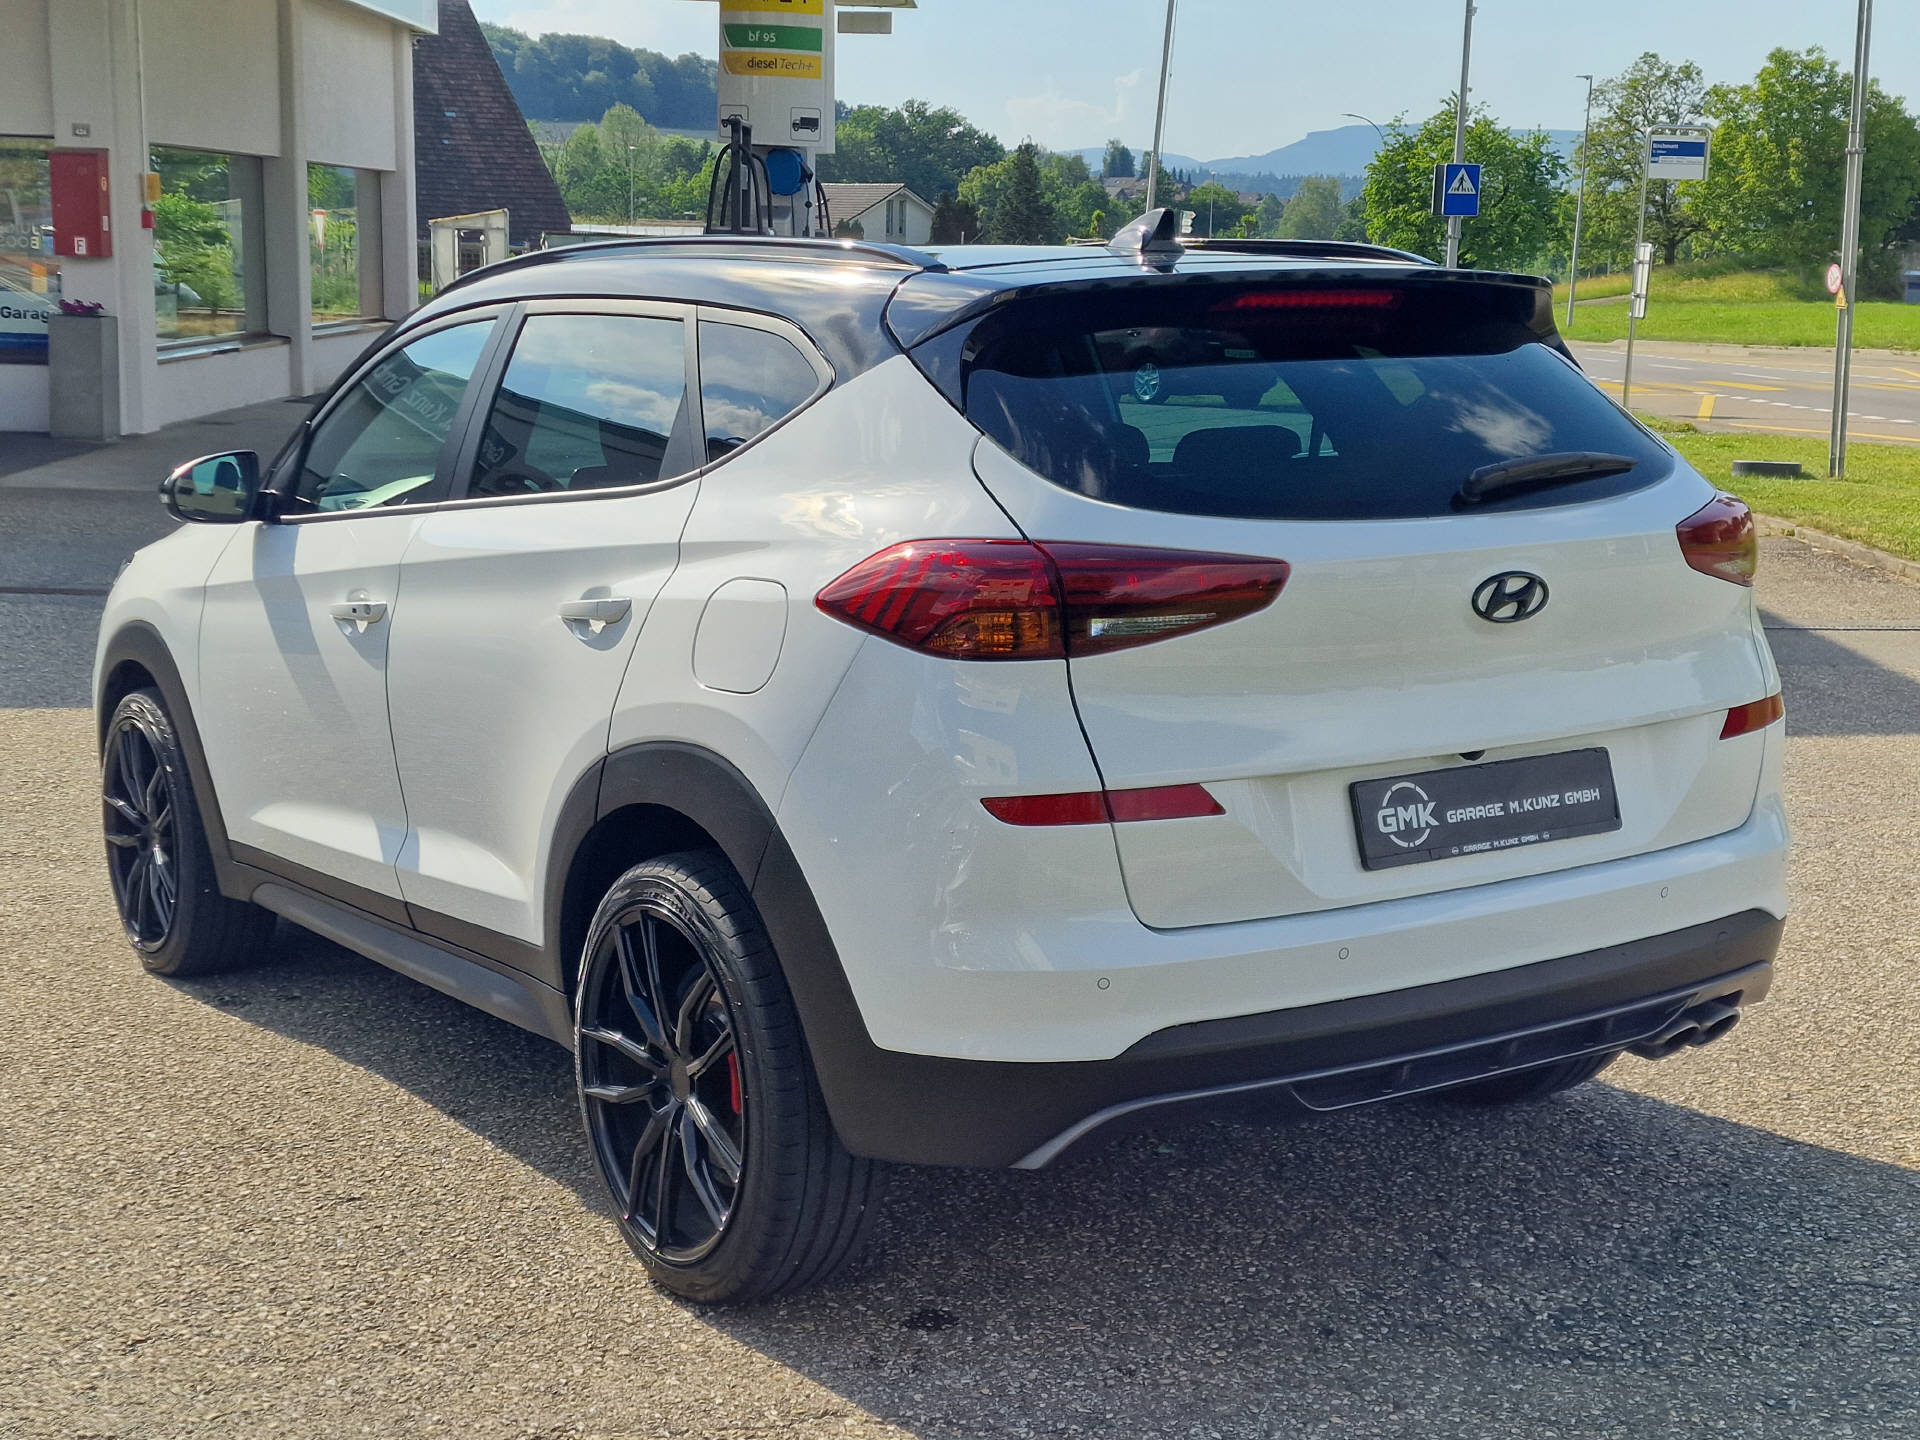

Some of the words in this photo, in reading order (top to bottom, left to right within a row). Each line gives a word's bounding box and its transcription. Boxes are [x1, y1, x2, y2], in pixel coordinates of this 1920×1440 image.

[748, 30, 760, 42] bf
[763, 32, 776, 43] 95
[747, 56, 777, 69] diesel
[780, 57, 814, 70] Tech+
[1446, 803, 1505, 823] GARAGE
[1509, 794, 1561, 814] M.KUNZ
[1564, 787, 1601, 805] GMBH
[1377, 801, 1440, 833] GMK
[1463, 840, 1491, 853] GARAGE
[1493, 837, 1519, 848] M.KUNZ
[1520, 833, 1539, 843] GMBH
